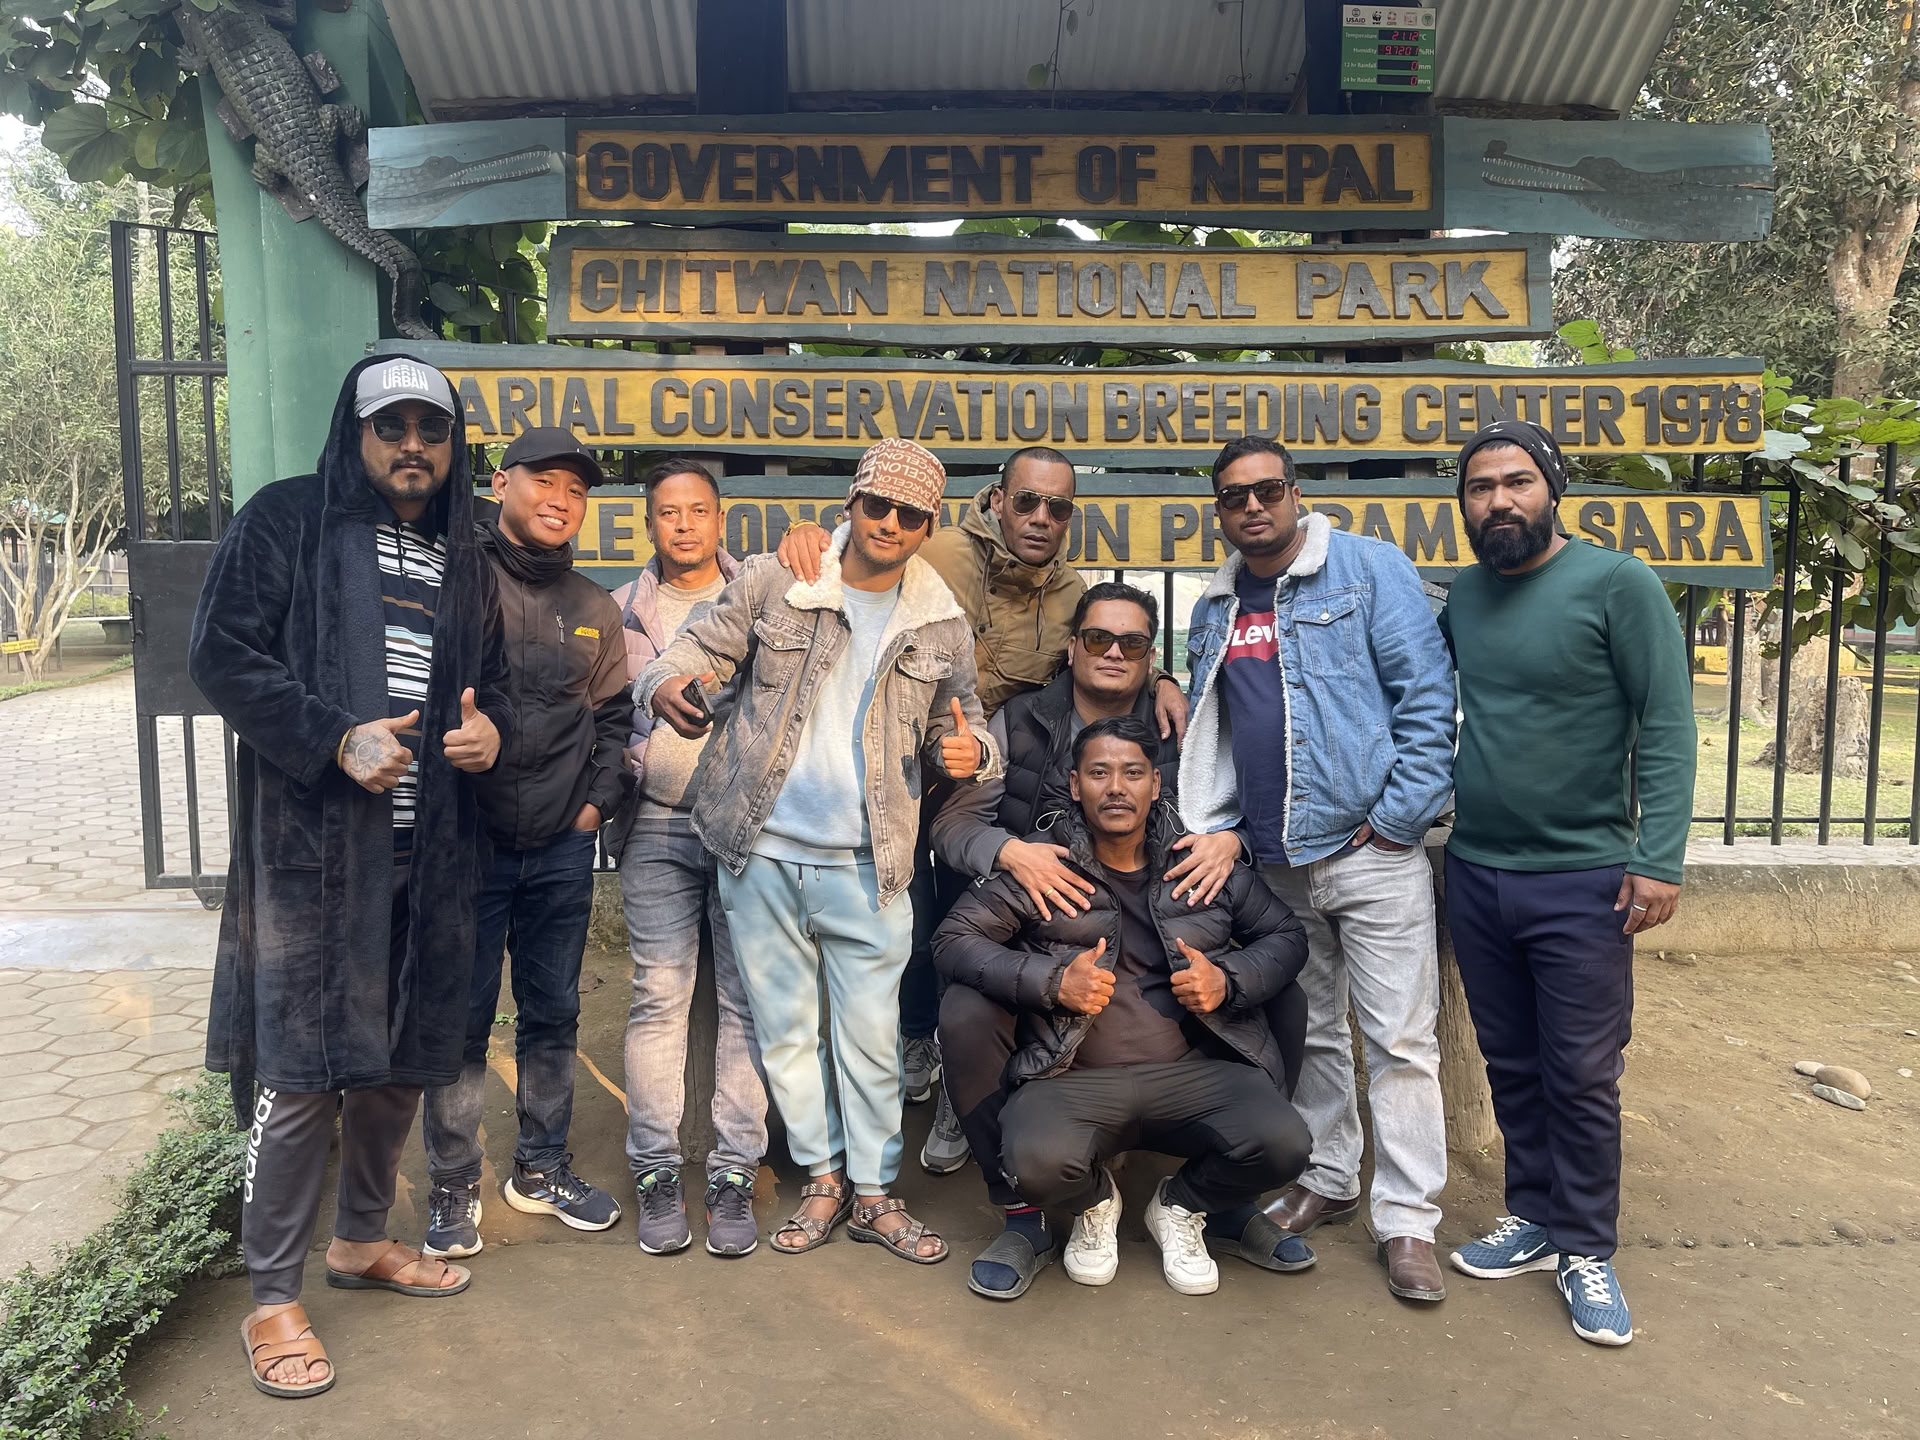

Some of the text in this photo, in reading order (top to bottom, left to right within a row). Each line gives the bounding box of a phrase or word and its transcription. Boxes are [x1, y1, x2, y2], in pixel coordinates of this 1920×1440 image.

[1345, 32, 1377, 40] Temperature
[1353, 47, 1377, 55] Humidity
[1419, 48, 1435, 56] %RH
[586, 142, 1414, 205] GOVERNMENT OF NEPAL
[580, 258, 1510, 320] CHITWAN NATIONAL PARK
[382, 367, 429, 391] URBAN
[459, 376, 635, 437] ARIAL
[650, 377, 1089, 442] CONSERVATION
[1103, 382, 1382, 443] BREEDING
[1402, 383, 1626, 445] CENTER
[1555, 500, 1754, 561] SARA
